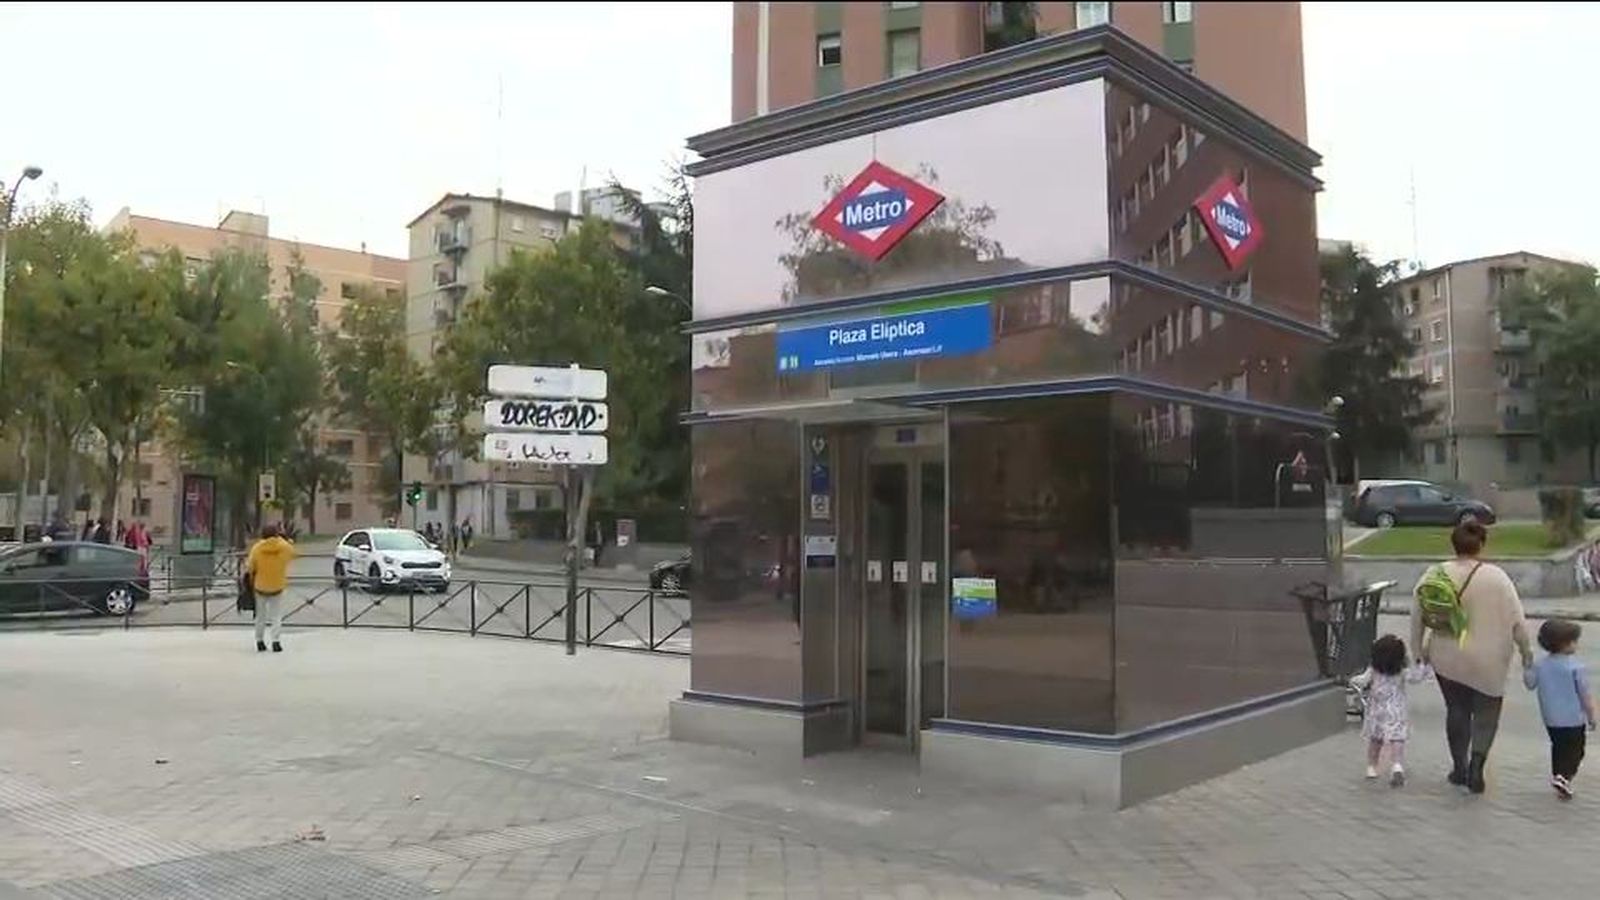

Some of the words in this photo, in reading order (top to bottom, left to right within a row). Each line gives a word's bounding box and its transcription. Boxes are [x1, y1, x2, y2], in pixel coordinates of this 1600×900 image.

[846, 201, 902, 226] Metro
[1216, 205, 1246, 236] Metro
[829, 328, 867, 346] Plaza
